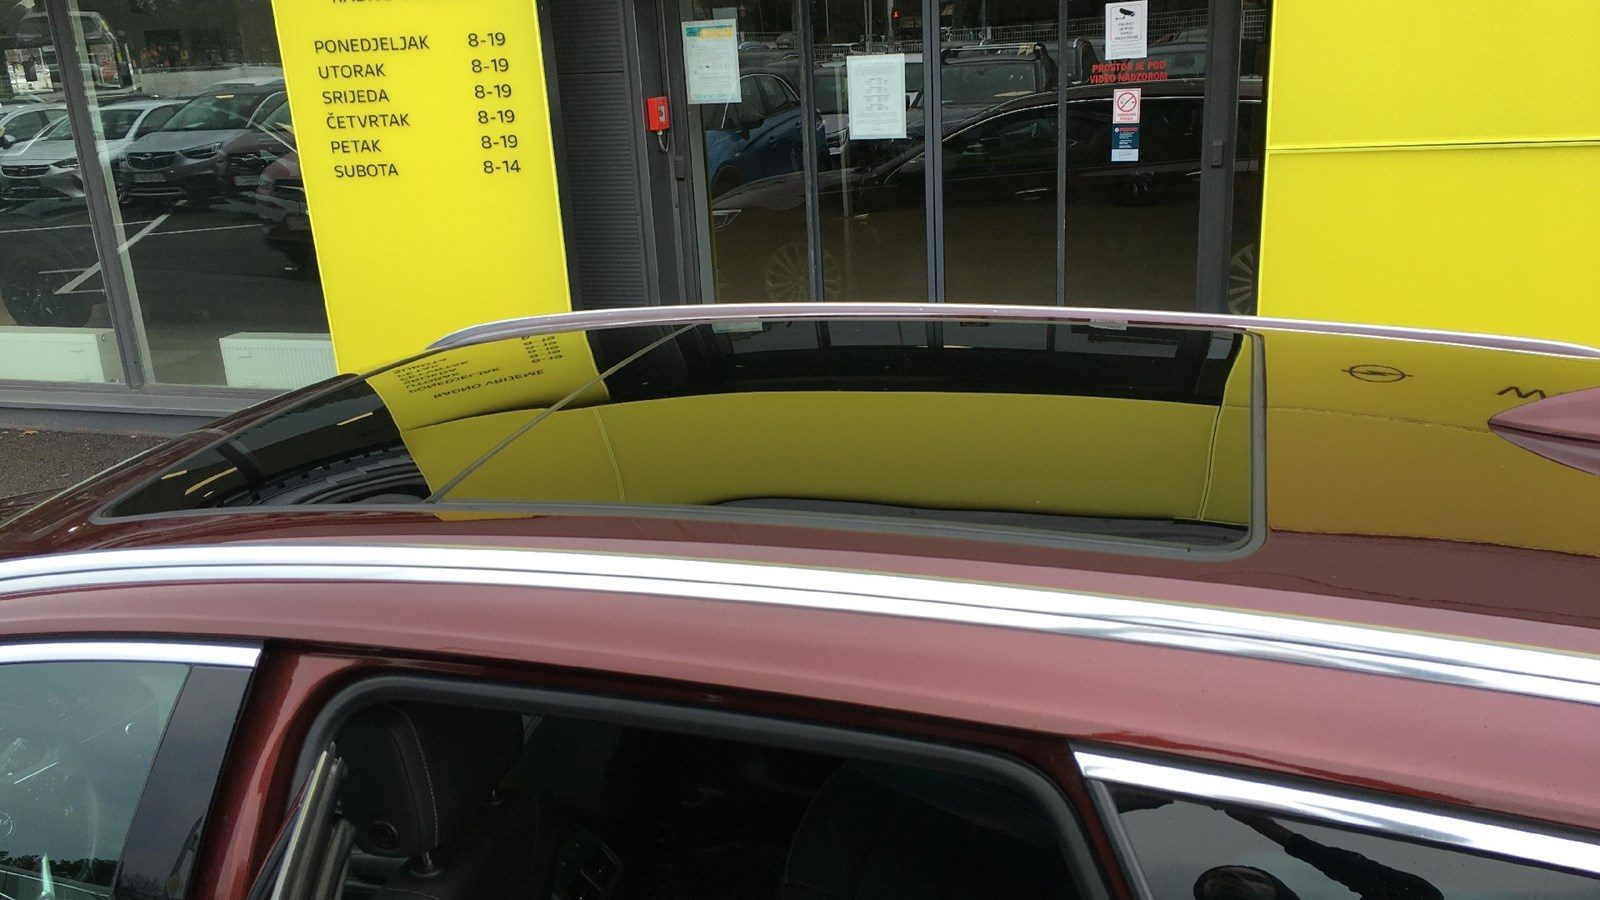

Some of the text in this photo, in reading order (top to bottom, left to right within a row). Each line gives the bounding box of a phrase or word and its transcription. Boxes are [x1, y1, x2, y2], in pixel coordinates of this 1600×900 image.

[314, 32, 506, 54] PONEDJELJAK 8-19
[318, 57, 509, 80] UTORAK 8-19
[1092, 61, 1167, 73] PROSTOR JE POD
[1089, 72, 1169, 84] VIDEO NADZOROM
[322, 83, 512, 105] SRIJEDA 8-19
[326, 109, 516, 129] ČETVRTAK 8-19
[330, 134, 518, 154] PETAK 8-19
[334, 160, 521, 178] SUBOTA 8-14
